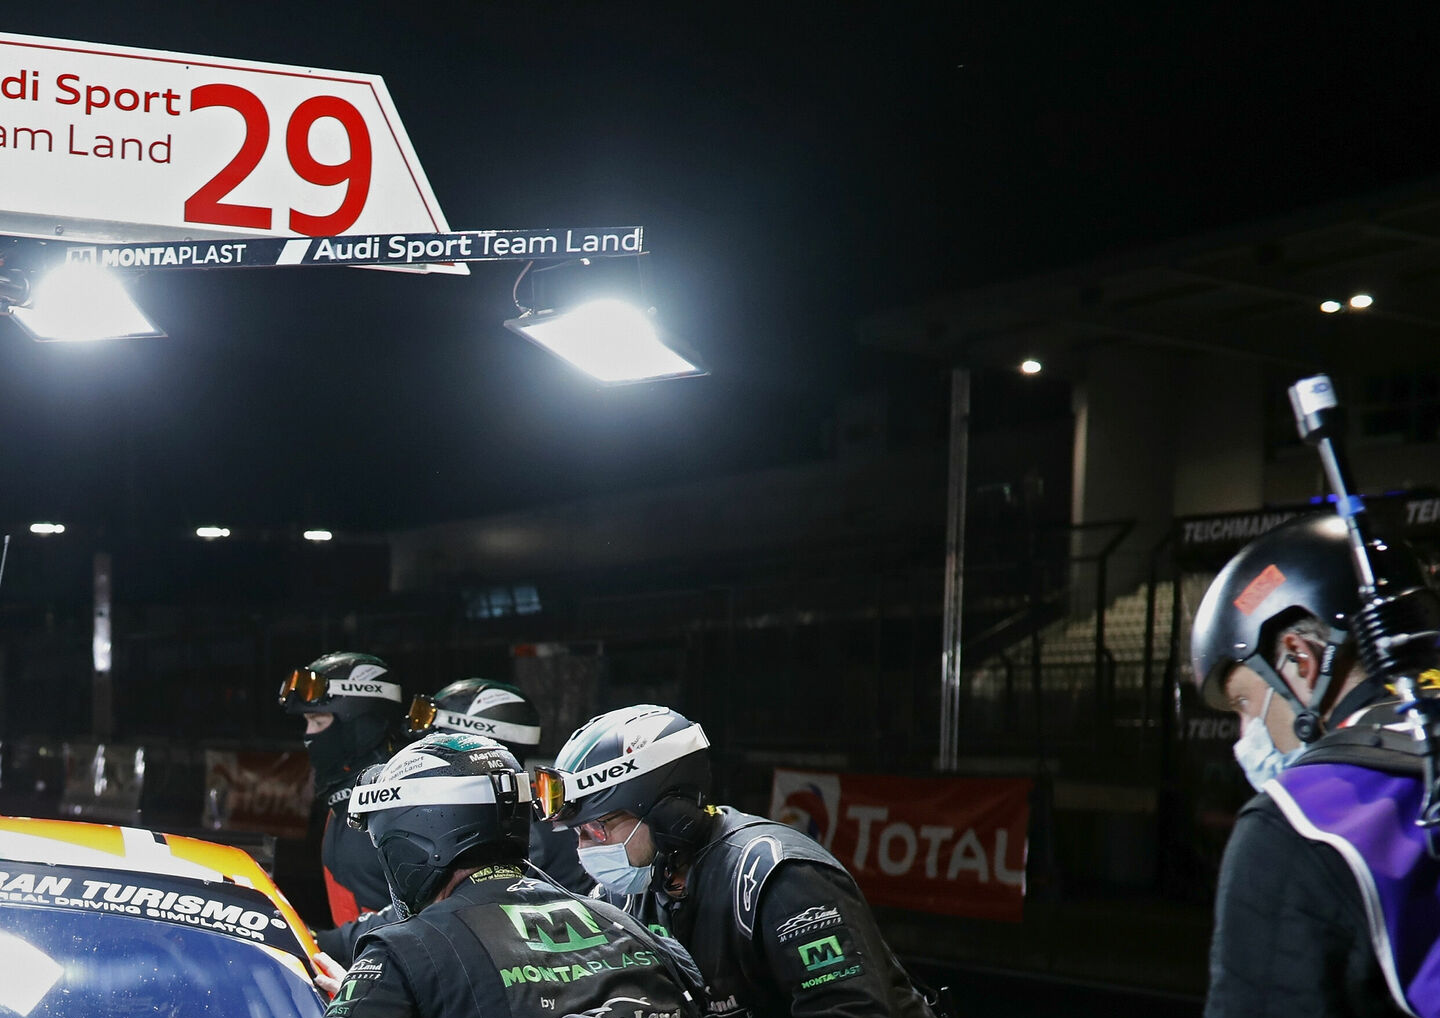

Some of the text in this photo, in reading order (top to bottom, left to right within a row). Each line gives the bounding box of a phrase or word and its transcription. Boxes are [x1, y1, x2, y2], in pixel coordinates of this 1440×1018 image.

[54, 73, 181, 116] Sport
[69, 123, 172, 164] Land
[183, 82, 373, 238] 29
[101, 243, 247, 267] MONTAPLAST
[312, 226, 641, 262] Audi Sport Team Land
[340, 682, 383, 694] uvex
[447, 716, 497, 735] uvex
[487, 760, 505, 769] MG
[576, 758, 640, 791] uvex
[358, 786, 402, 806] uvex
[846, 804, 1024, 886] TOTAL
[53, 896, 142, 915] DRIVING
[146, 908, 265, 942] SIMULATOR
[499, 950, 661, 988] MONTAPLAST
[801, 964, 861, 989] MONTAPLAST
[540, 996, 556, 1011] by
